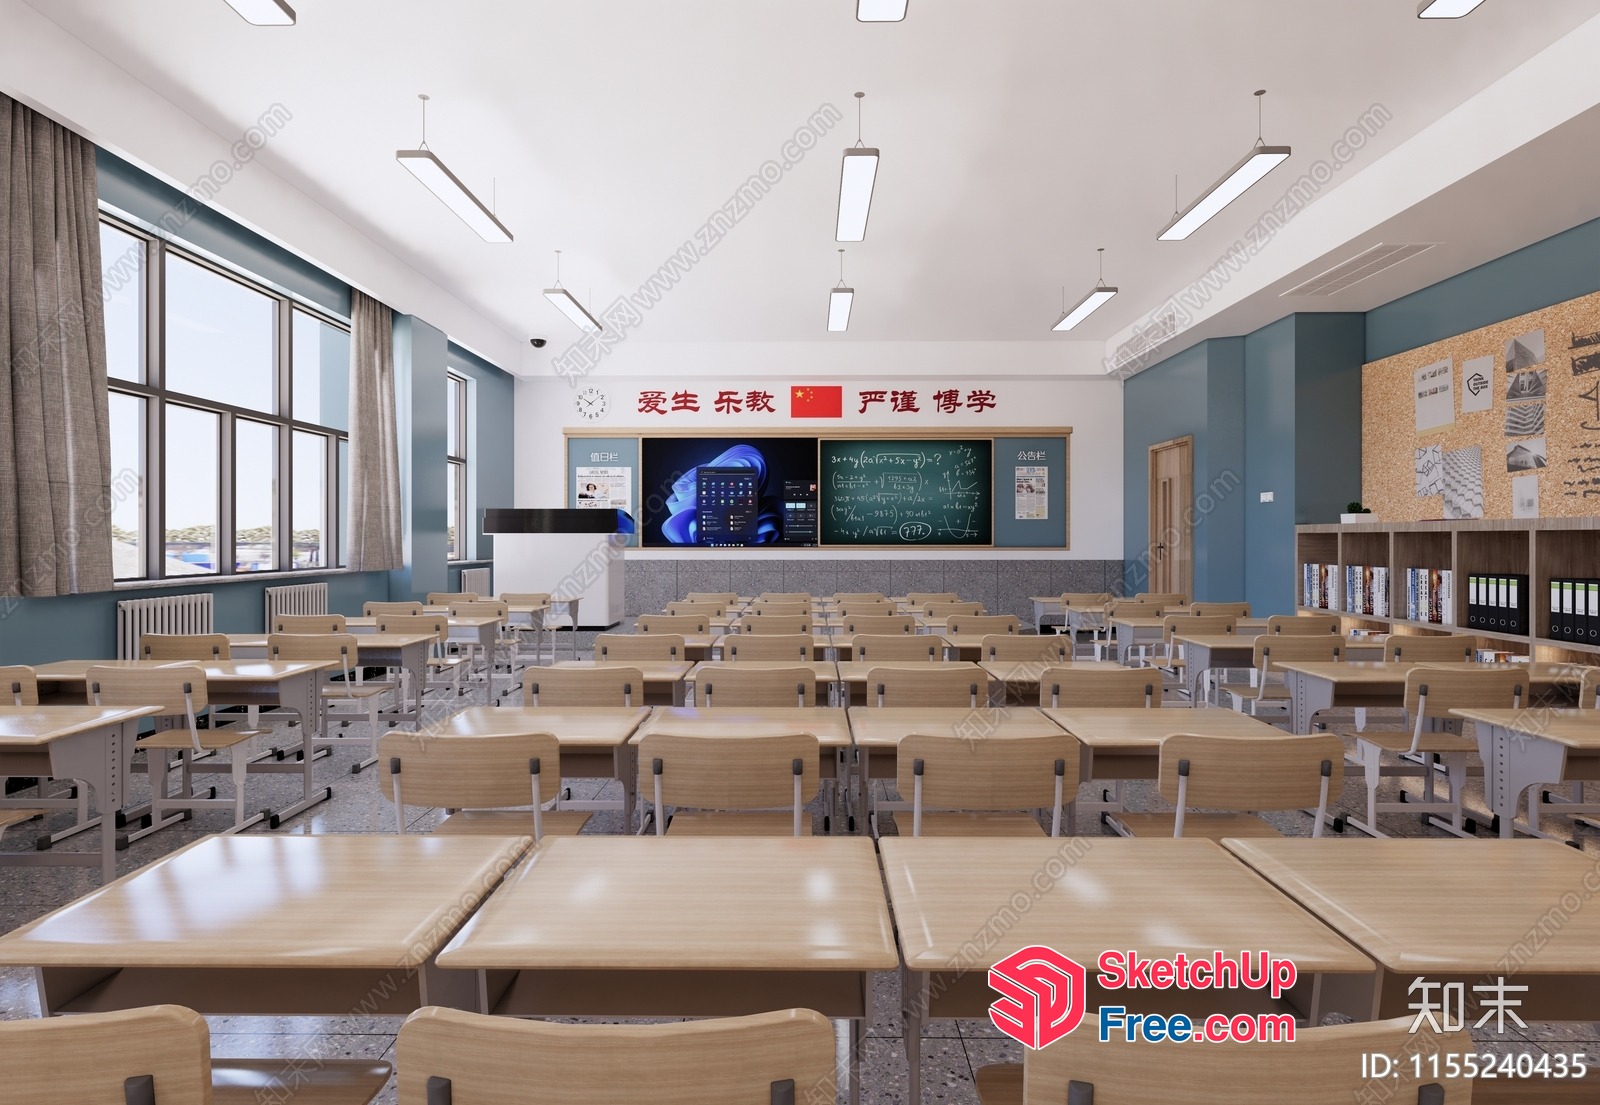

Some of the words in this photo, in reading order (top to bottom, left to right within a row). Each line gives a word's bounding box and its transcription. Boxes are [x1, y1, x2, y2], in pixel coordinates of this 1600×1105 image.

[638, 390, 700, 415] 爱生
[714, 390, 776, 414] 乐教
[858, 390, 920, 414] 严谨
[933, 390, 996, 414] 博学
[590, 452, 619, 462] 值日栏
[1017, 450, 1046, 461] 公告栏
